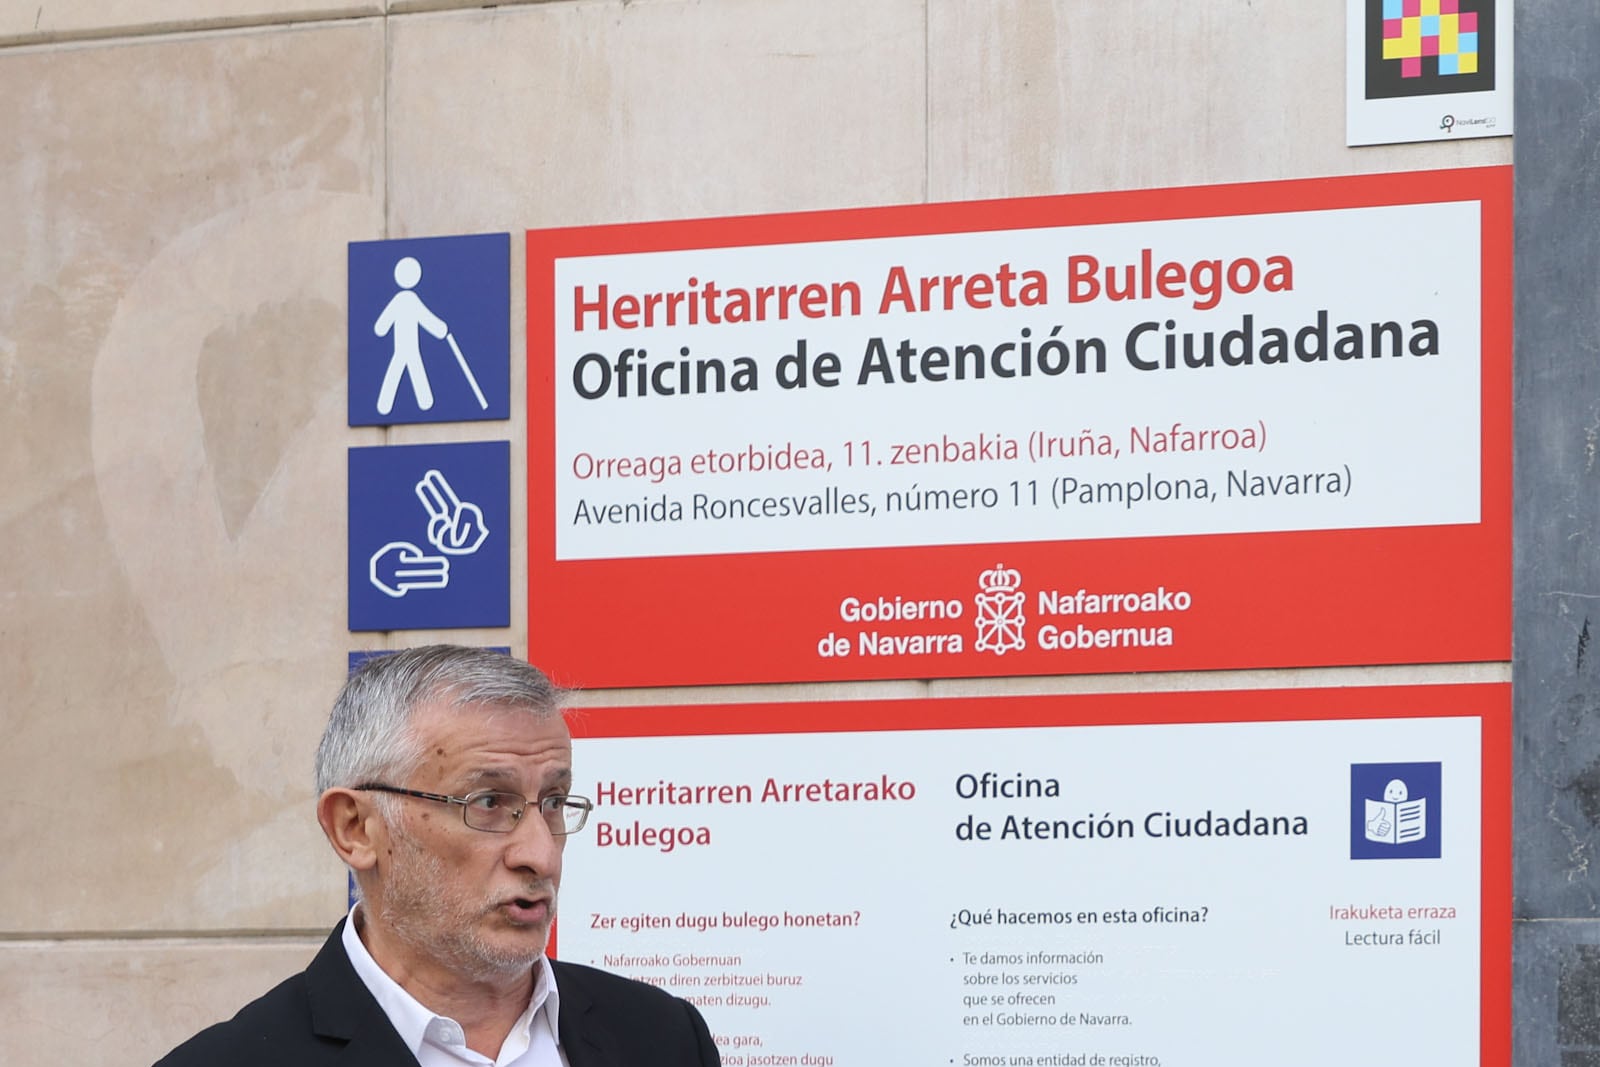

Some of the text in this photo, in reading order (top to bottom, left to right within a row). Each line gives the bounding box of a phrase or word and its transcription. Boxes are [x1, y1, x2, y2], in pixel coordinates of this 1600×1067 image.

[574, 249, 1293, 332] Herritarren Arreta Bulegoa
[573, 310, 1439, 400] Oficina de Atención Ciudadana
[573, 421, 1266, 483] Orreaga etorbidea, 11. zenbakia (Iruña, Nafarroa)
[573, 465, 1351, 525] Avenida Roncesvalles, número 11 (Pamplona, Navarra)
[840, 596, 963, 622] Gobierno
[1039, 587, 1192, 615] Nafarroako
[818, 632, 962, 657] de Navarra
[1038, 624, 1172, 650] Gobernua
[596, 775, 915, 806] Herritarren Arretarako
[956, 772, 1059, 799] Oficina
[956, 810, 1307, 840] de Atención Ciudadana
[597, 821, 710, 852] Bulegoa
[591, 911, 860, 932] Zer egiten dugu bulego honetan?
[950, 907, 1208, 929] ¿Qué hacemos en esta oficina?
[1330, 904, 1456, 920] Irakuketa erraza
[1346, 929, 1440, 945] Lectura fácil
[603, 954, 741, 967] Nafarroako Gobernuan
[963, 951, 1103, 965] Te damos información
[670, 976, 700, 985] diren
[705, 975, 764, 985] zerbitzuei
[768, 975, 801, 984] buruz
[964, 972, 1077, 985] sobre los servicios
[726, 994, 771, 1008] dizugu.
[963, 992, 1055, 1008] que ofrecen
[997, 1013, 1132, 1025] Gobierno de Navarra.
[733, 1035, 763, 1049] gara,
[747, 1056, 797, 1067] jasotzen
[801, 1054, 832, 1067] dugu
[964, 1054, 1006, 1066] Somos
[1010, 1057, 1033, 1066] una
[1037, 1053, 1085, 1066] entidad
[1089, 1053, 1105, 1066] de
